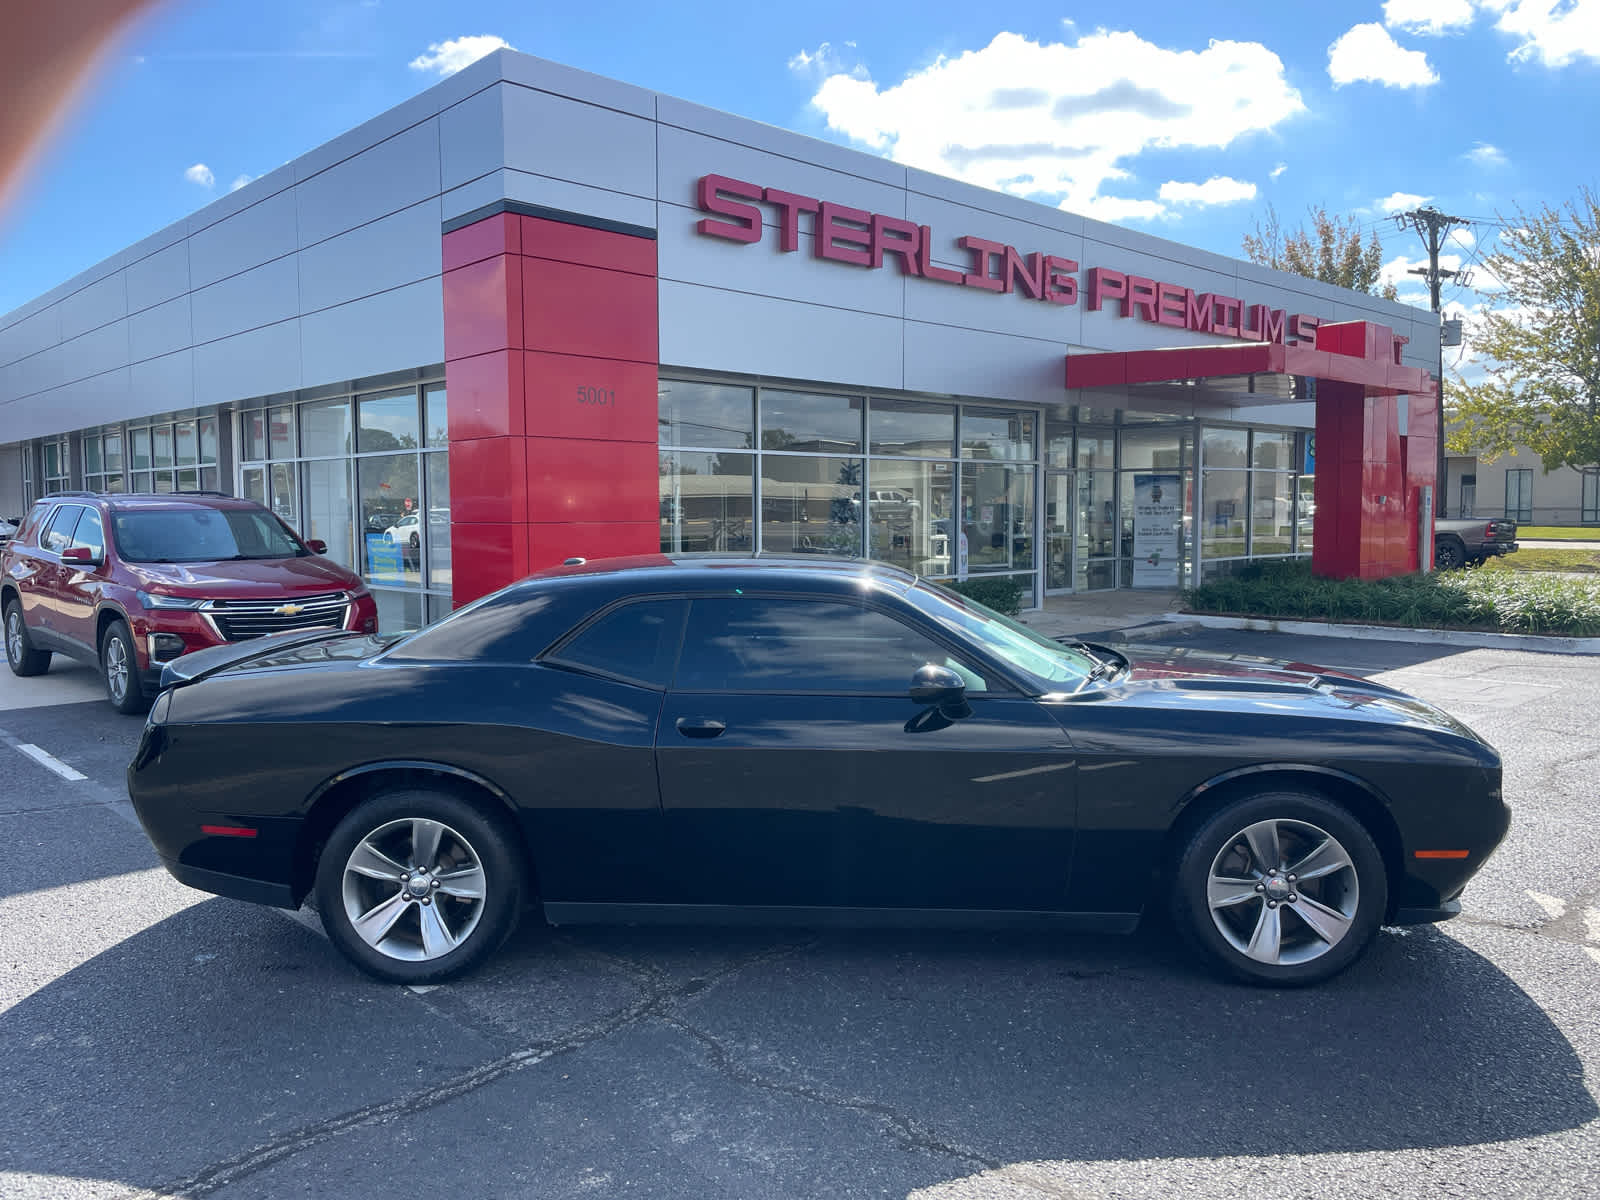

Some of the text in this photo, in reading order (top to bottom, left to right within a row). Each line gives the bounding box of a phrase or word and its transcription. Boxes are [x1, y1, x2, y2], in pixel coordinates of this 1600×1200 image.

[697, 173, 1078, 305] STERLING
[1087, 267, 1286, 344] PREMIUM
[577, 386, 615, 406] 5001
